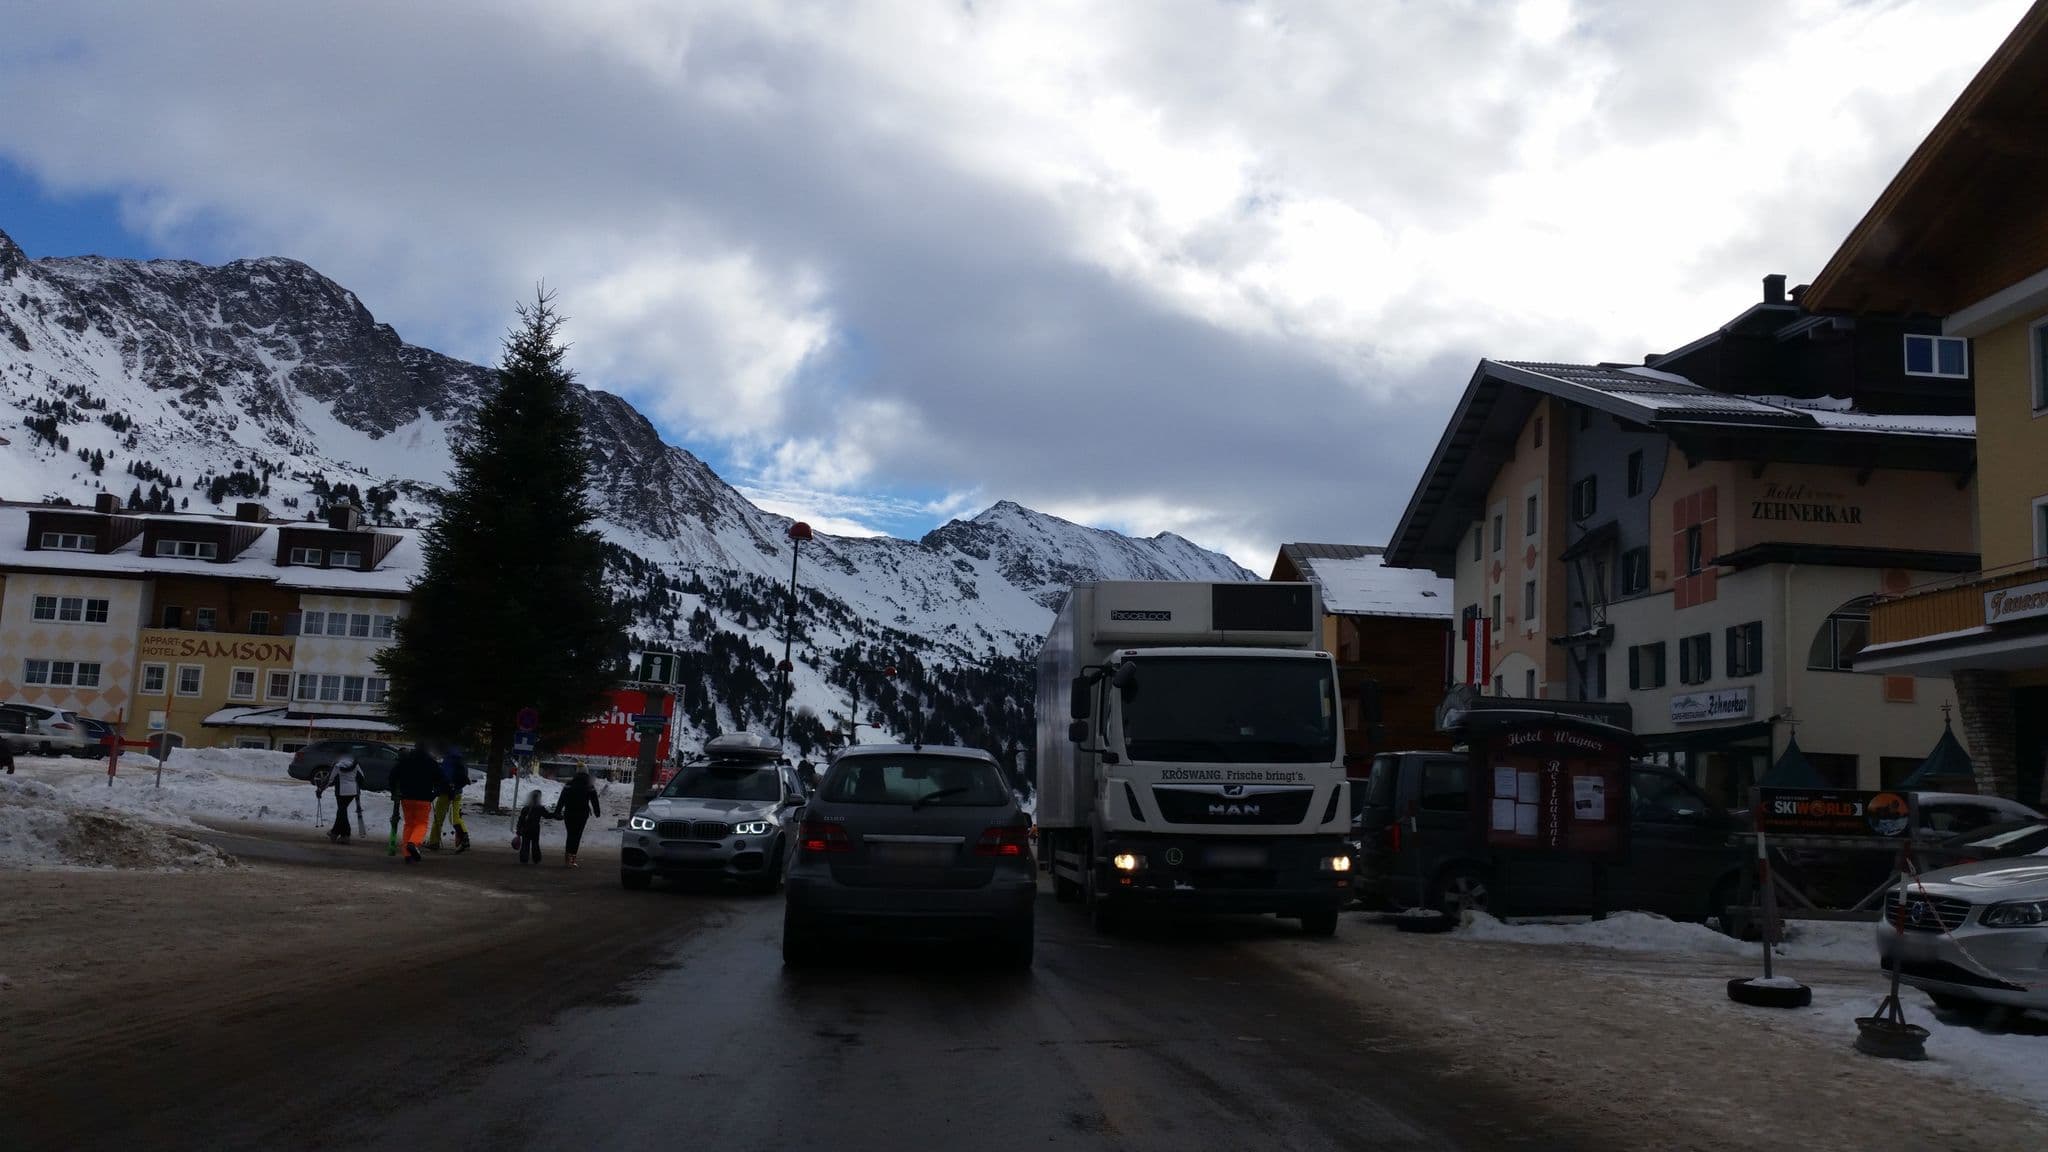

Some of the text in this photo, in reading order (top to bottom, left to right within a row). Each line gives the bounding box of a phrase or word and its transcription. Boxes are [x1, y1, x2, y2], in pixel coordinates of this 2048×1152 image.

[1751, 501, 1863, 524] ZEHNERKAR
[142, 646, 177, 658] HOTEL
[180, 638, 293, 662] SAMSON
[1707, 691, 1748, 717] Zehnerkar
[1506, 730, 1605, 752] Hotel Wagner
[1161, 767, 1224, 780] KRÖSWANG.
[1227, 769, 1263, 780] Frische
[1208, 803, 1261, 816] MAN
